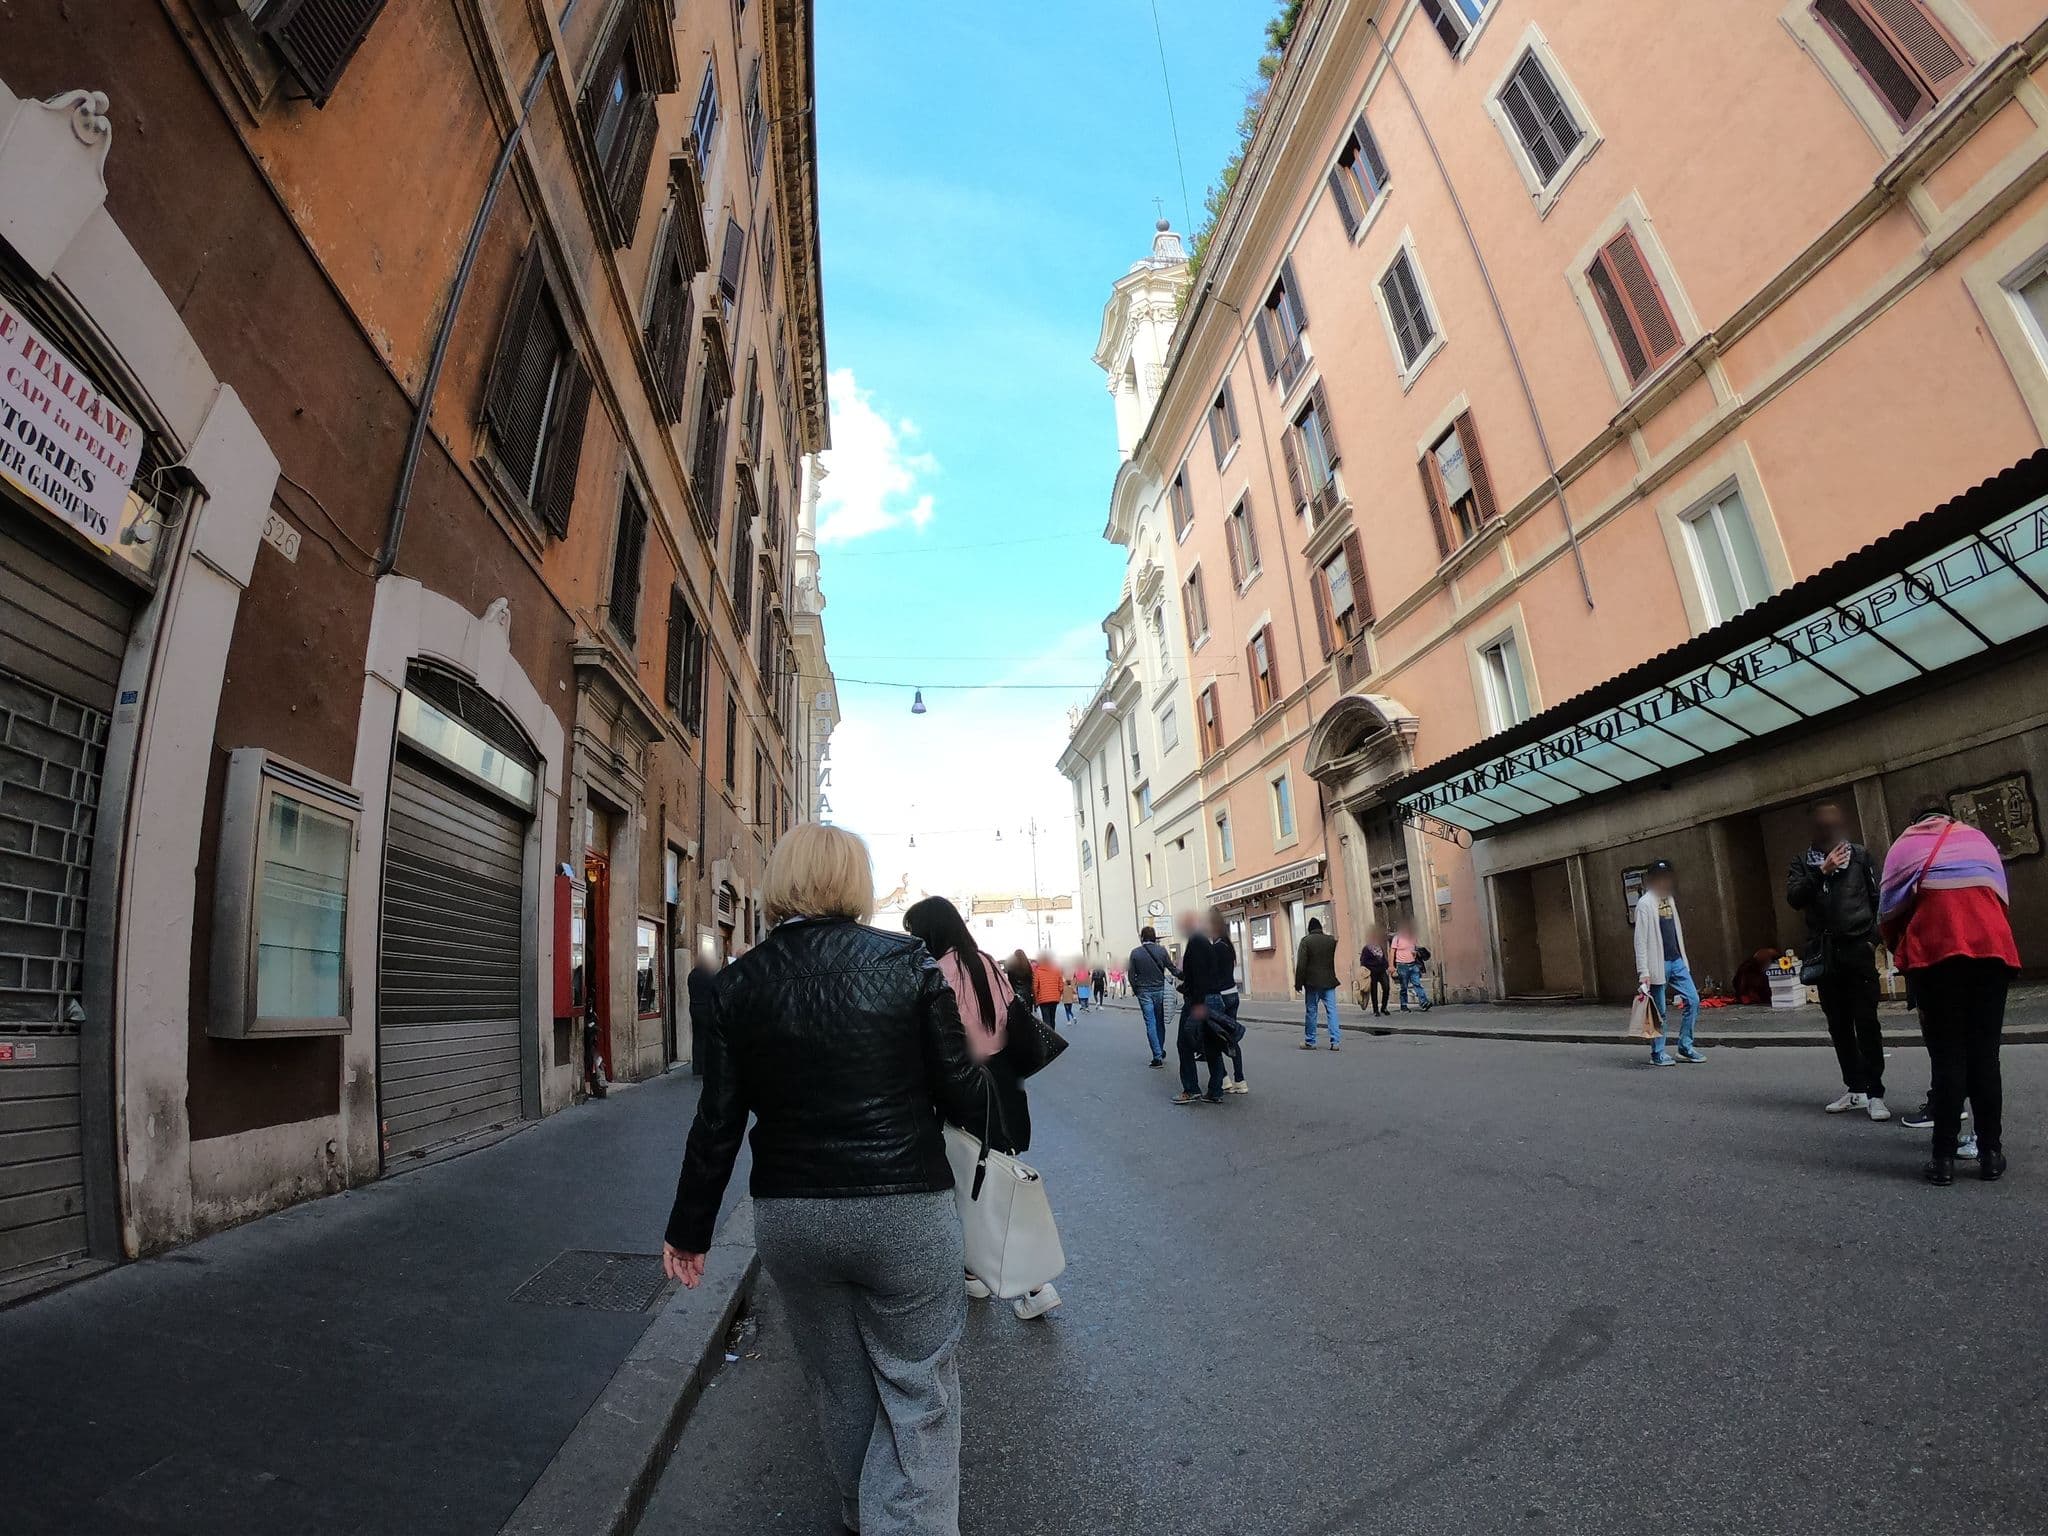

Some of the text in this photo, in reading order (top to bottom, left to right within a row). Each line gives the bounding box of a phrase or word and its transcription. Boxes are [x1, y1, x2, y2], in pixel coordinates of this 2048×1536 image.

[0, 307, 132, 449] E ITALIANE
[7, 367, 128, 480] CAPI in PELLE
[0, 397, 96, 493] TORIES
[28, 464, 109, 536] GARMENTS
[263, 516, 299, 555] 526
[1497, 676, 1710, 783] METROPOLITAN
[1273, 868, 1307, 885] RESTAURANT
